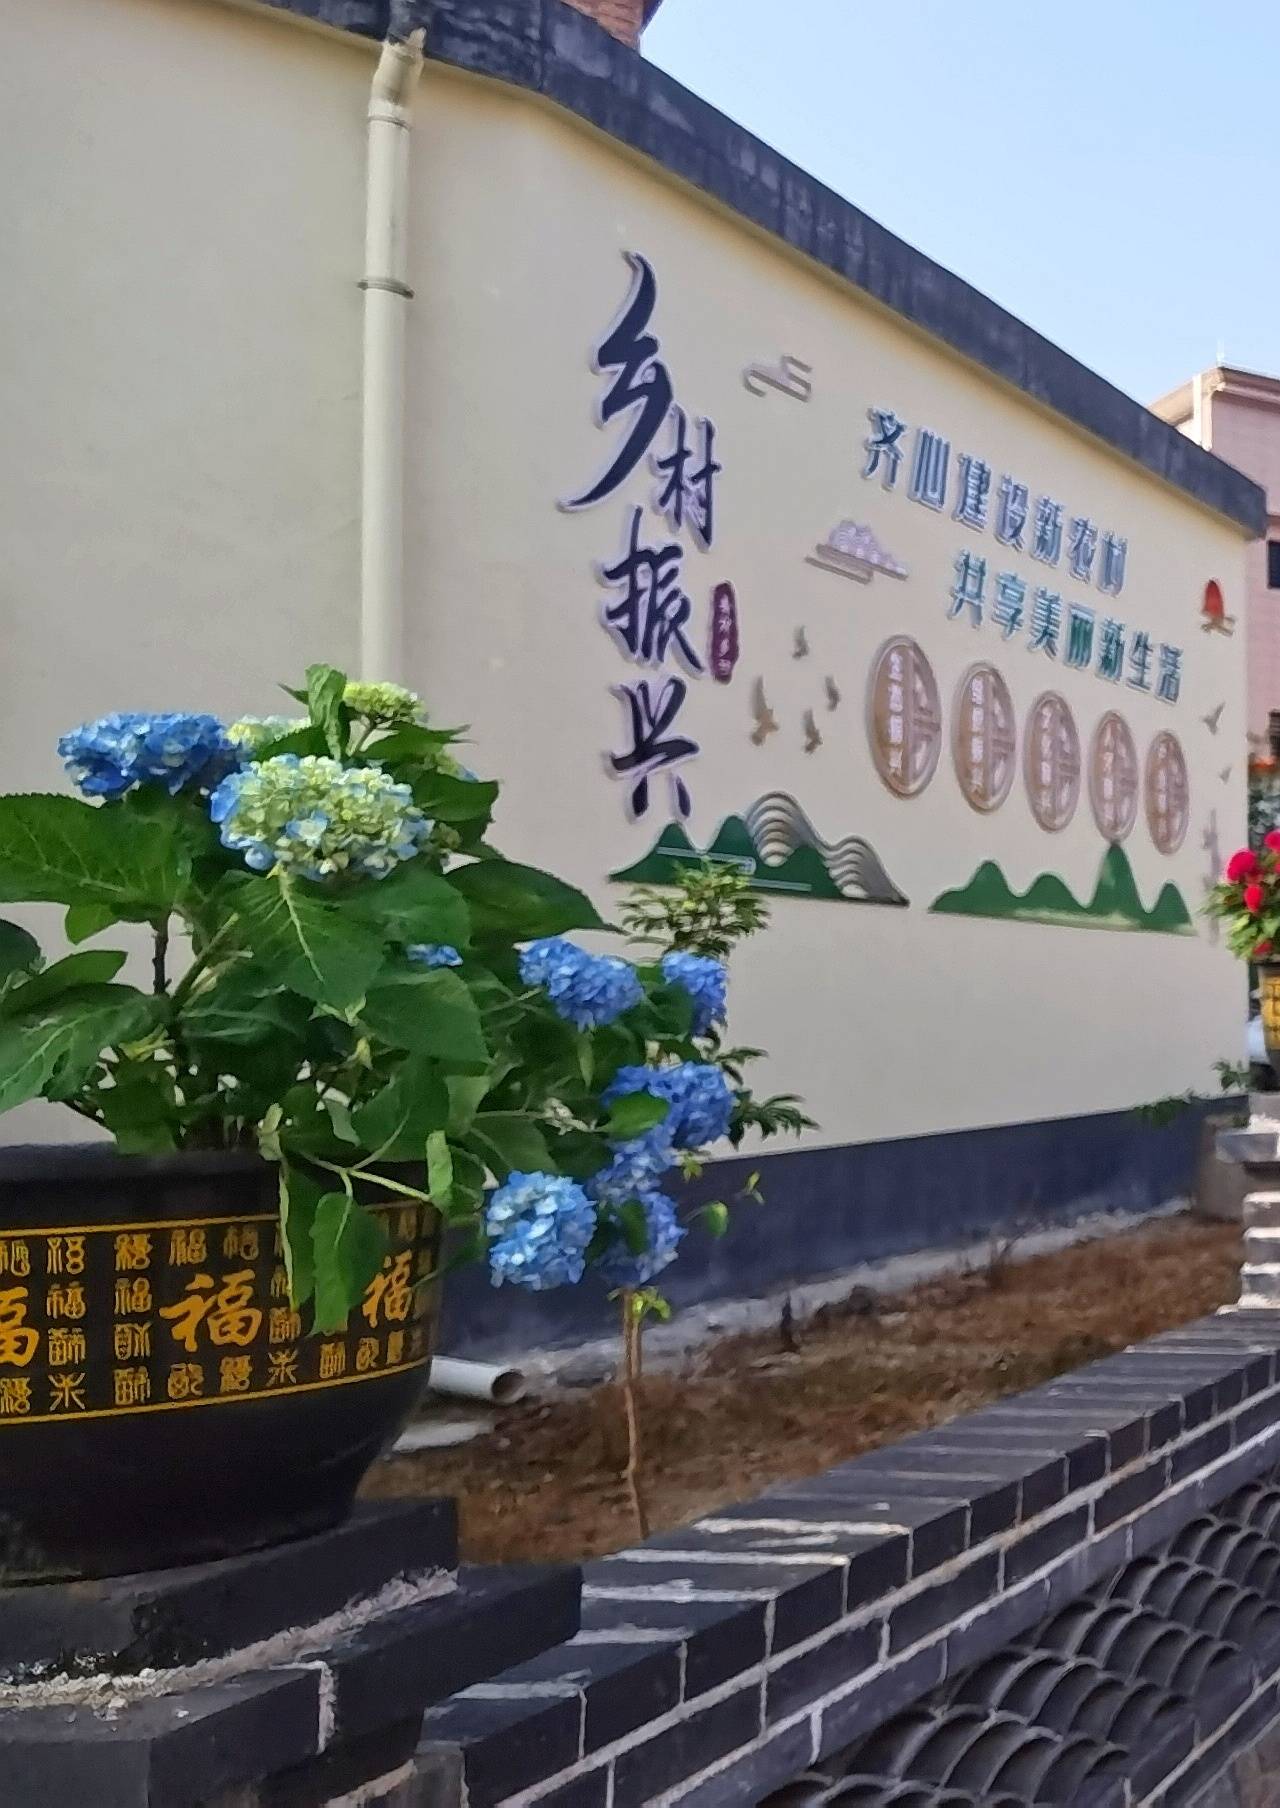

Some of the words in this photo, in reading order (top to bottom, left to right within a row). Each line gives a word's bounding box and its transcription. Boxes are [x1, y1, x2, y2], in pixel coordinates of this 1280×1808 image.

[560, 250, 720, 820] 乡村振兴
[862, 406, 1128, 597] 齐心建设新农村
[947, 550, 1184, 704] 共享美丽新生活
[160, 1268, 263, 1353] 福
